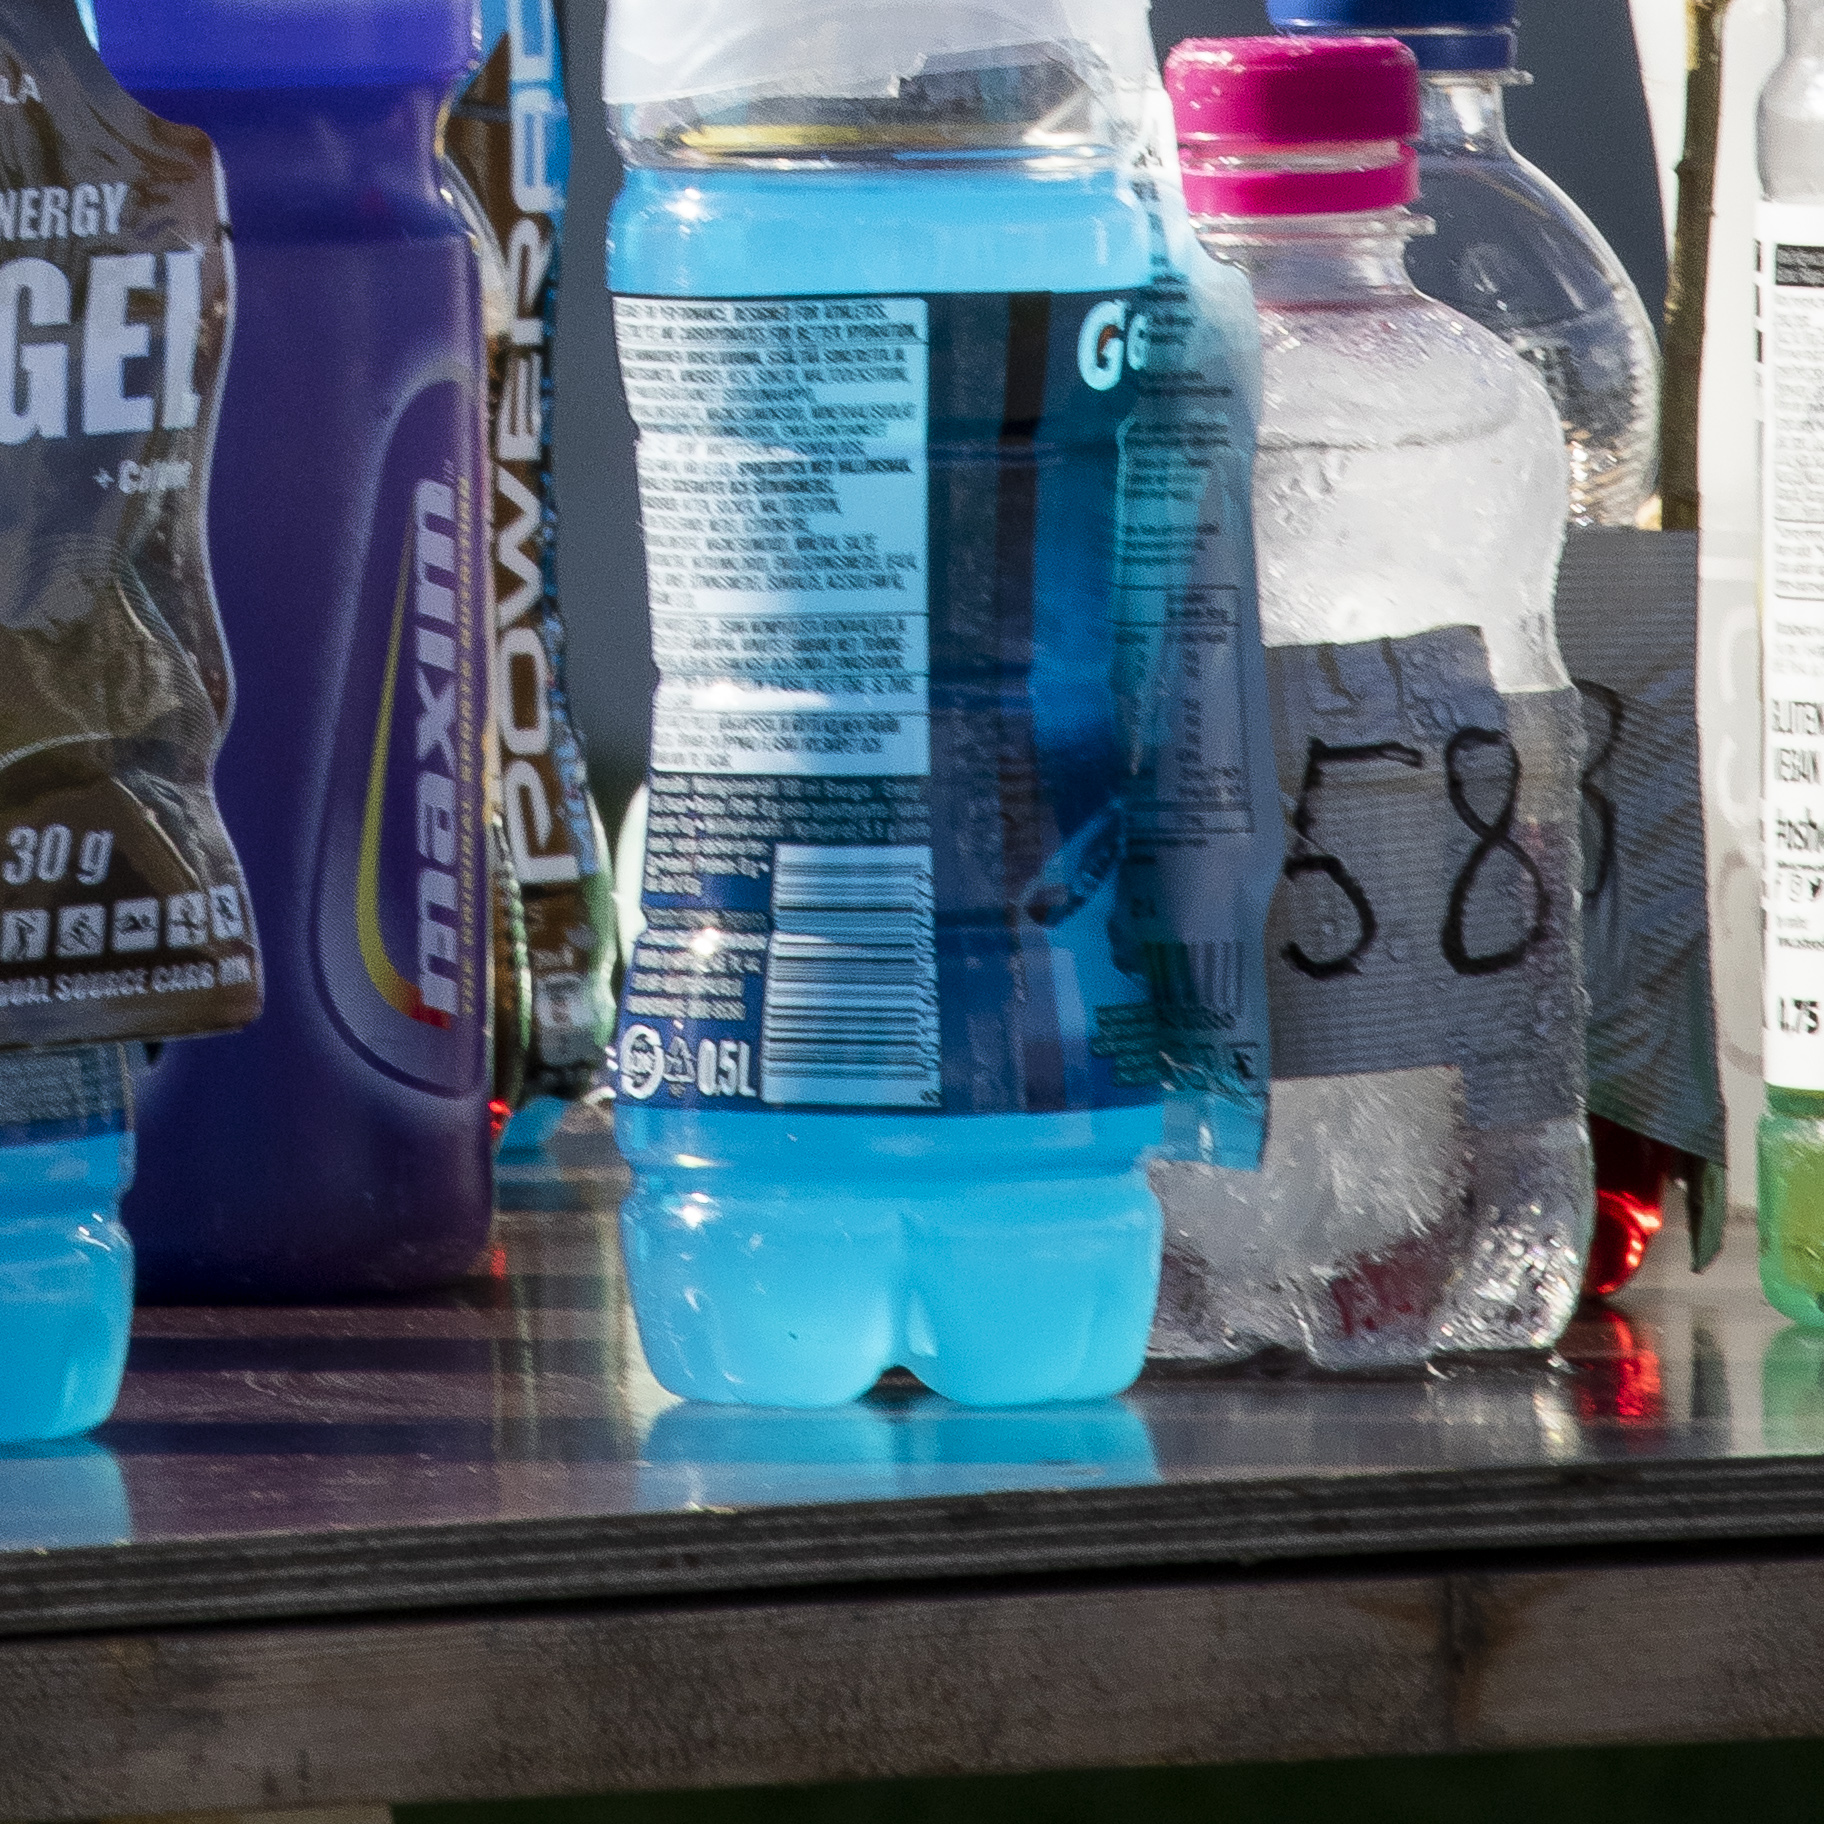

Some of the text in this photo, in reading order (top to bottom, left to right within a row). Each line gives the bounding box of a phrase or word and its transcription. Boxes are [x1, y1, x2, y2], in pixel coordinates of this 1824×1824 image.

[1, 824, 114, 886] 30 g
[414, 477, 459, 1016] maxim
